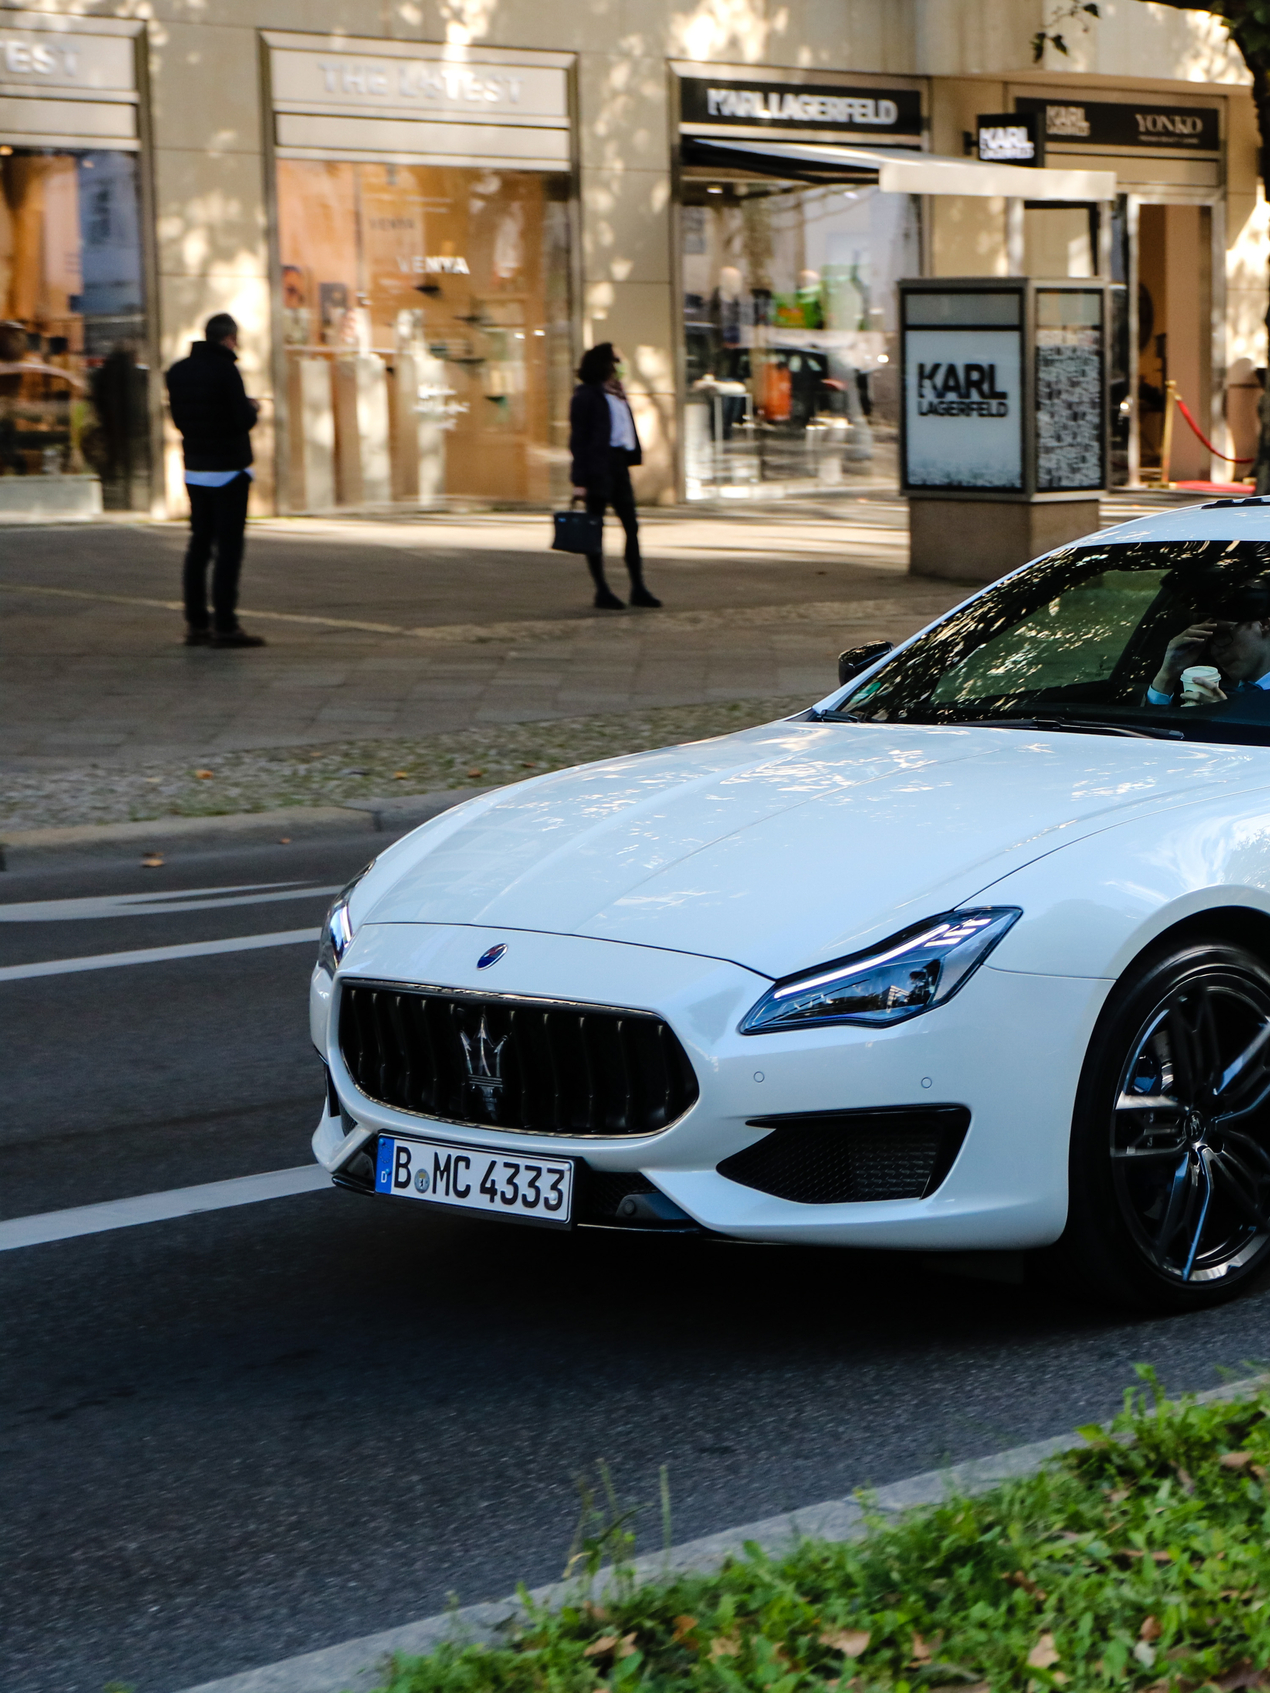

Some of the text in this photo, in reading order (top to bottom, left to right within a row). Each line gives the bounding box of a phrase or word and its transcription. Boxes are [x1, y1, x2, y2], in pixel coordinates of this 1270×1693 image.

[318, 61, 525, 104] THE LATEST
[707, 88, 898, 126] KARL LAGERFELD
[1135, 114, 1204, 135] YONKO
[979, 126, 1034, 149] KARL
[917, 363, 1008, 400] KARL
[917, 400, 1009, 418] LAGERFELD
[393, 1145, 566, 1212] B MC 4333
